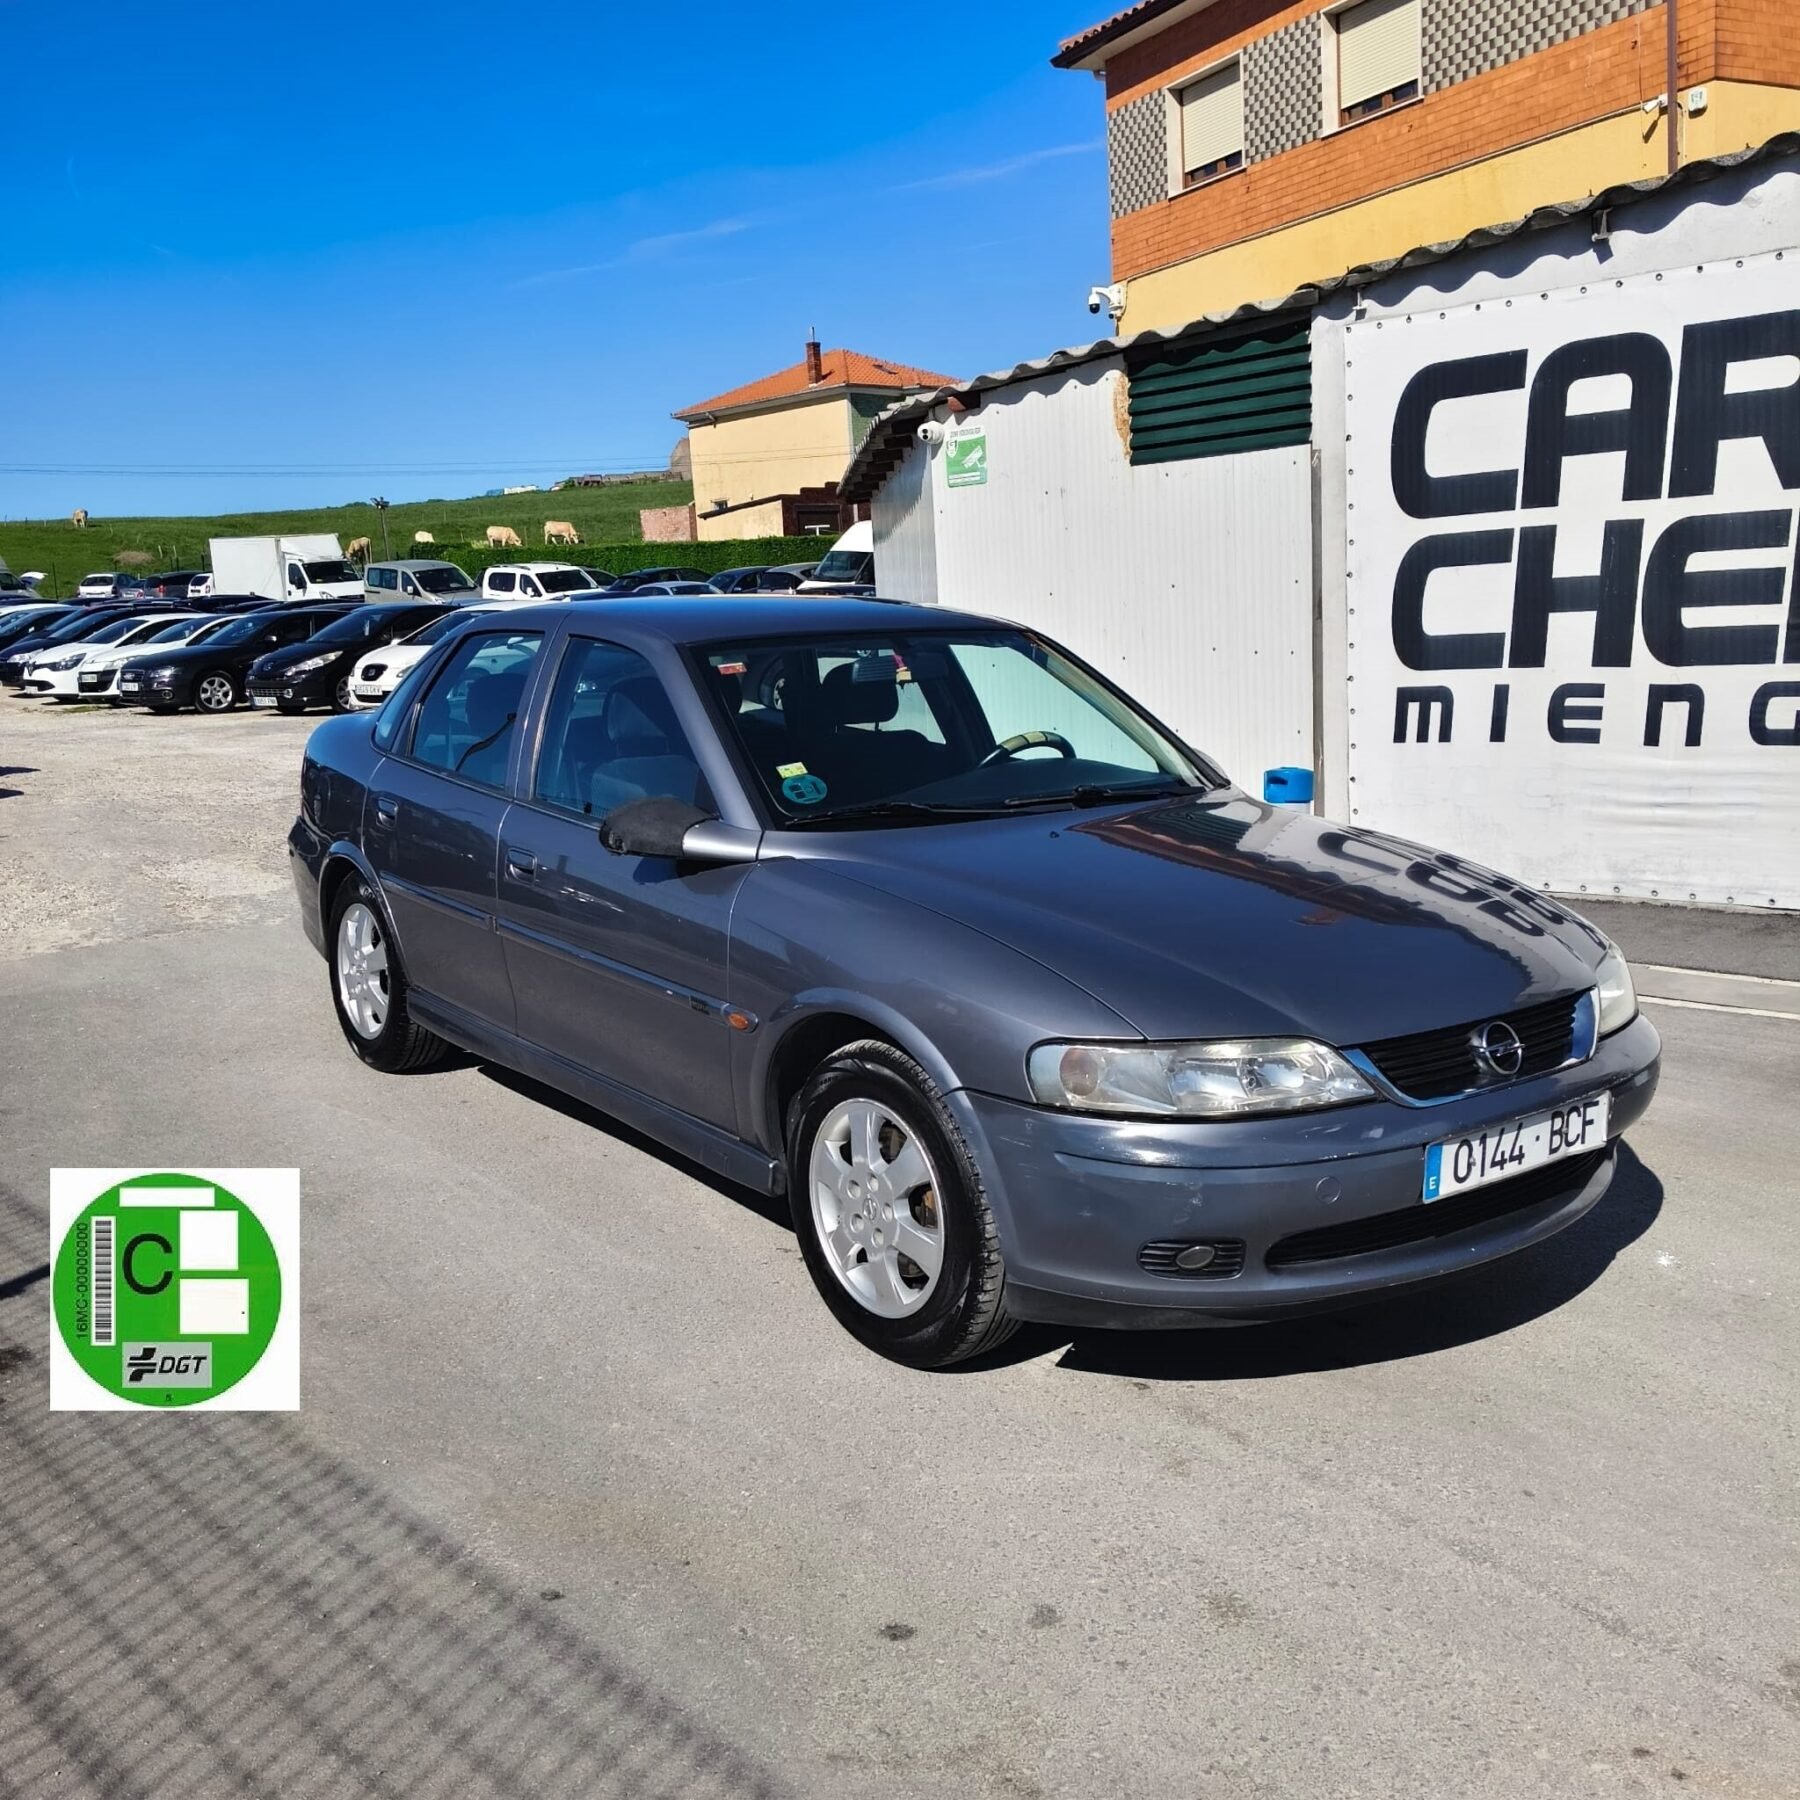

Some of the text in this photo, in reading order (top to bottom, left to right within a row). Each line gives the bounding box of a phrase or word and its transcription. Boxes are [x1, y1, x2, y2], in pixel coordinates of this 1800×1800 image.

[1391, 508, 1800, 671] CHE
[1428, 1176, 1437, 1190] E
[1453, 1100, 1600, 1184] 0144 BCF
